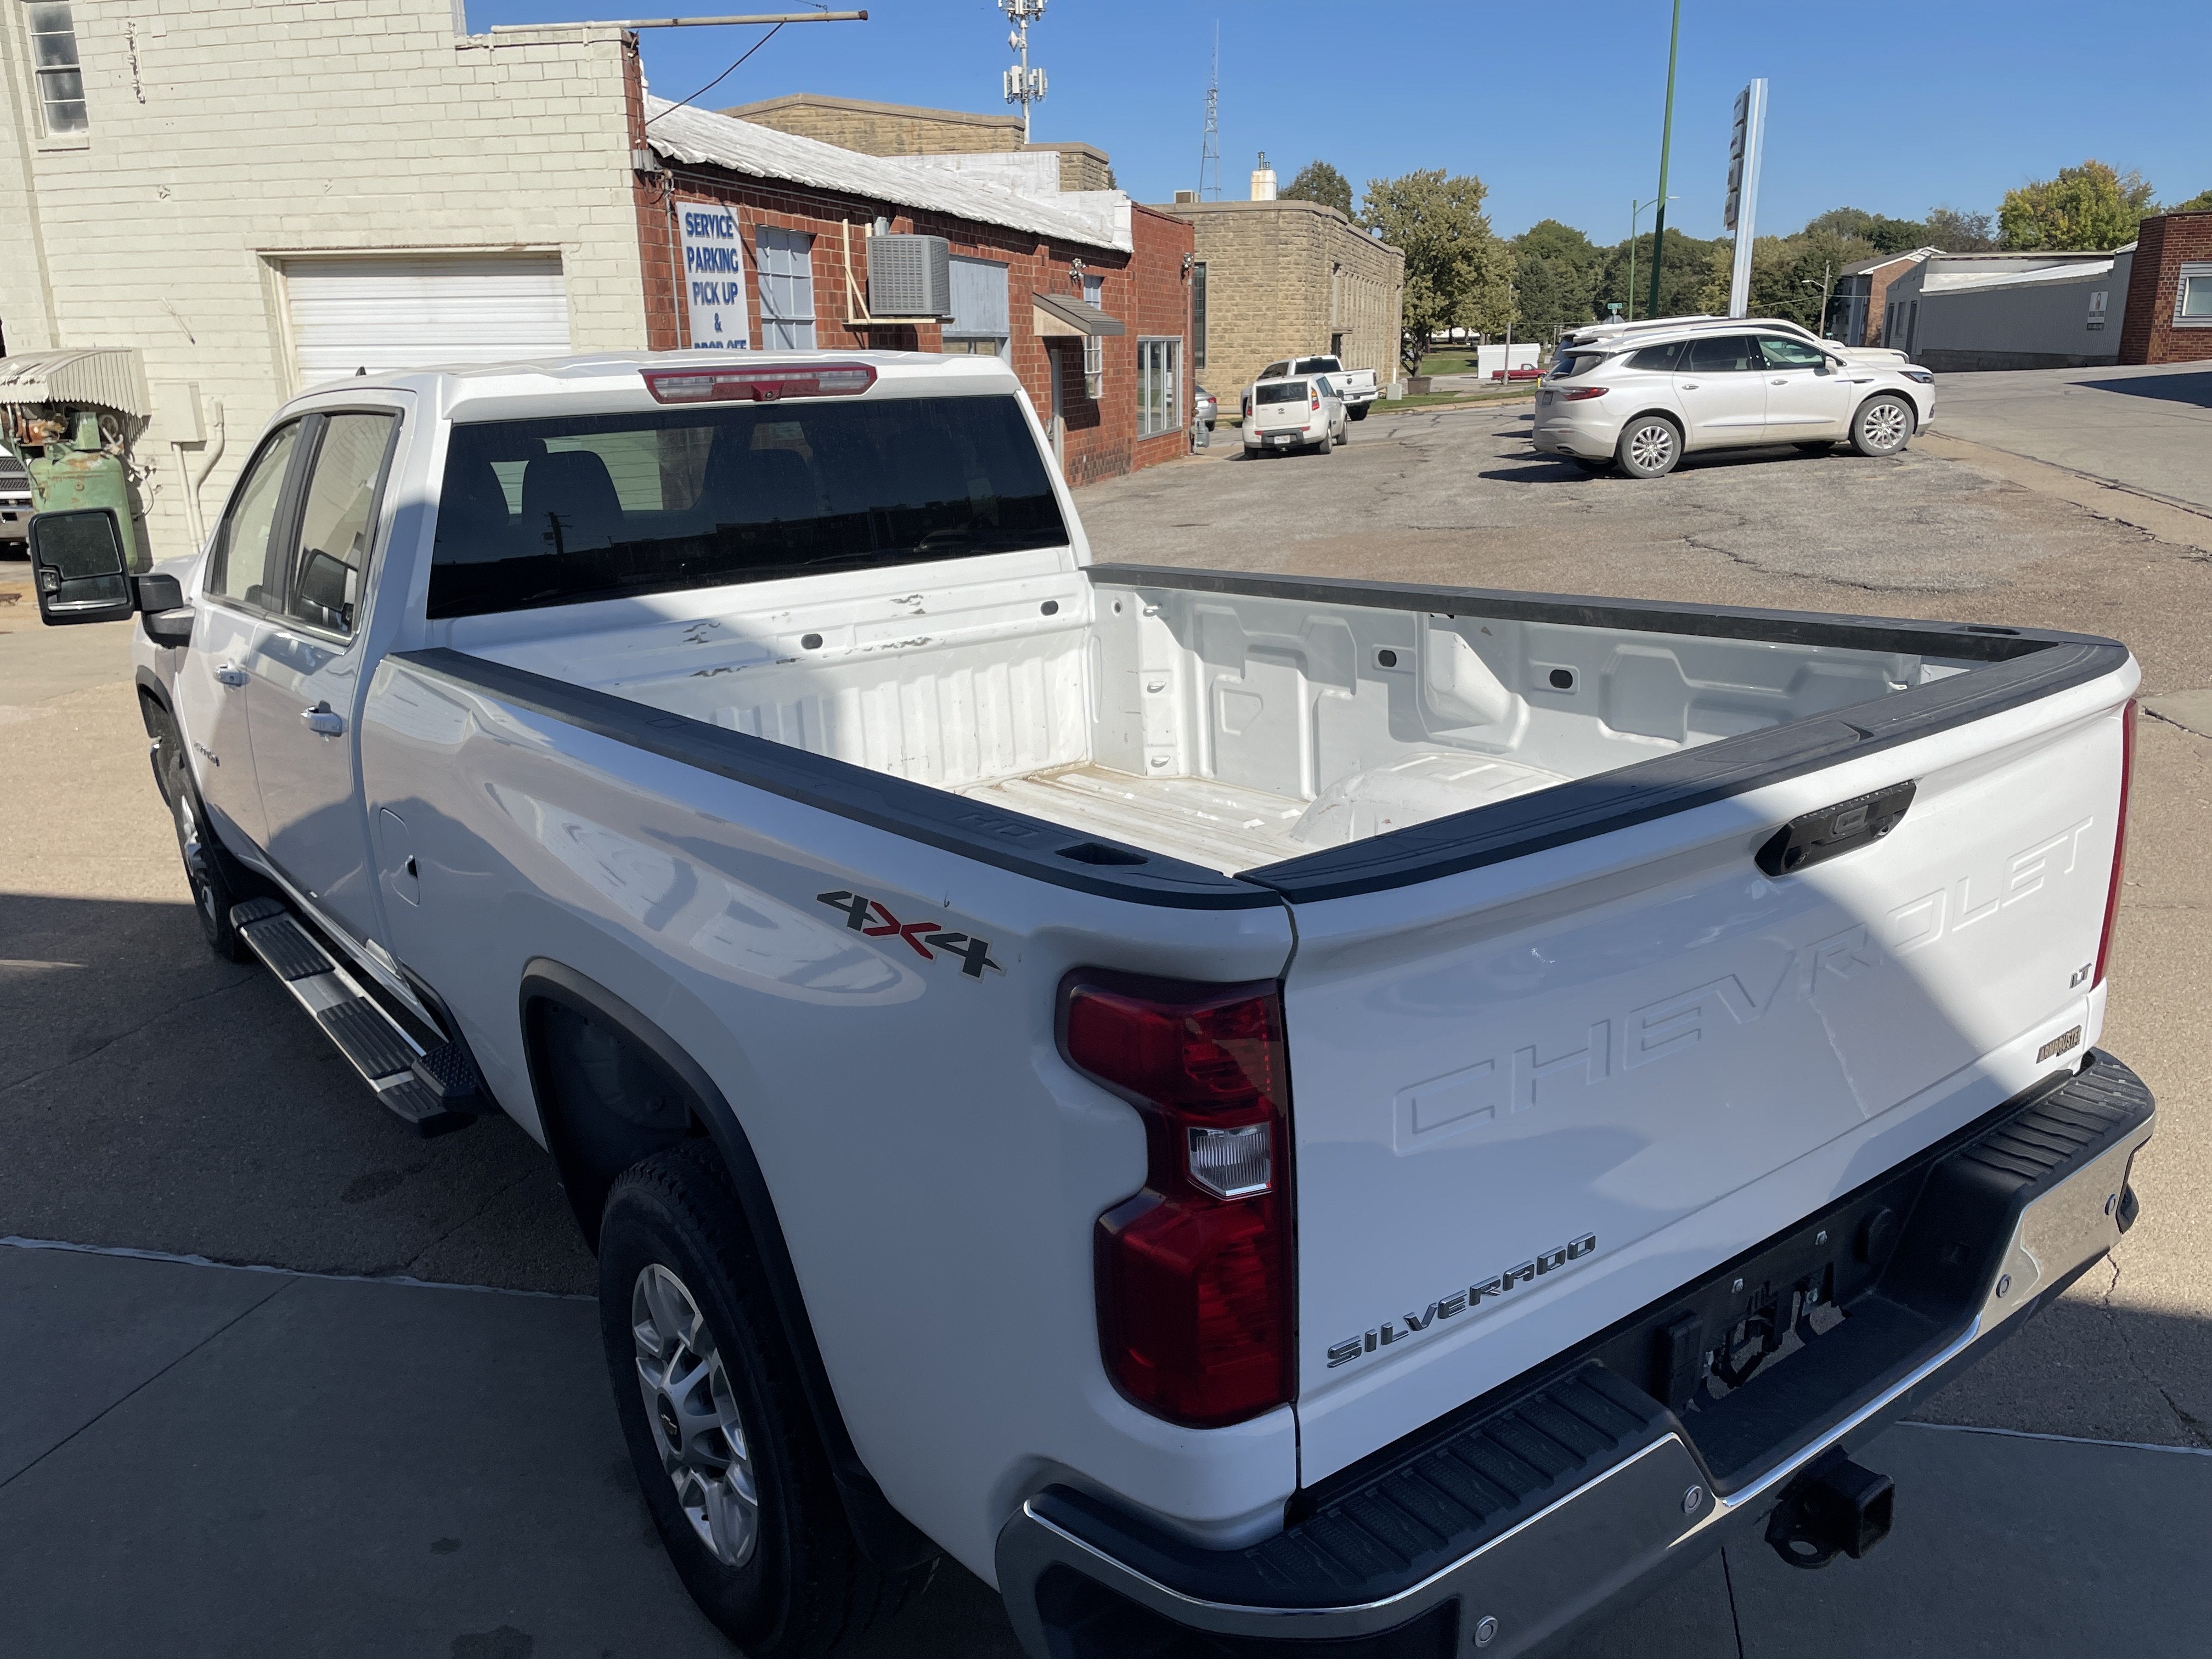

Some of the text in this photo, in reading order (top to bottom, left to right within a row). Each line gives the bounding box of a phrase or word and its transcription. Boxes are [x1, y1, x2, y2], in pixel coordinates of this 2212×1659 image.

[685, 212, 733, 239] SERVICE
[687, 246, 738, 274] PARKING
[693, 281, 737, 306] PICK UP
[714, 313, 722, 332] &
[1392, 815, 2095, 1159] CHEVROLET
[2069, 962, 2092, 989] LT
[1327, 1232, 1596, 1368] SILVERADO
